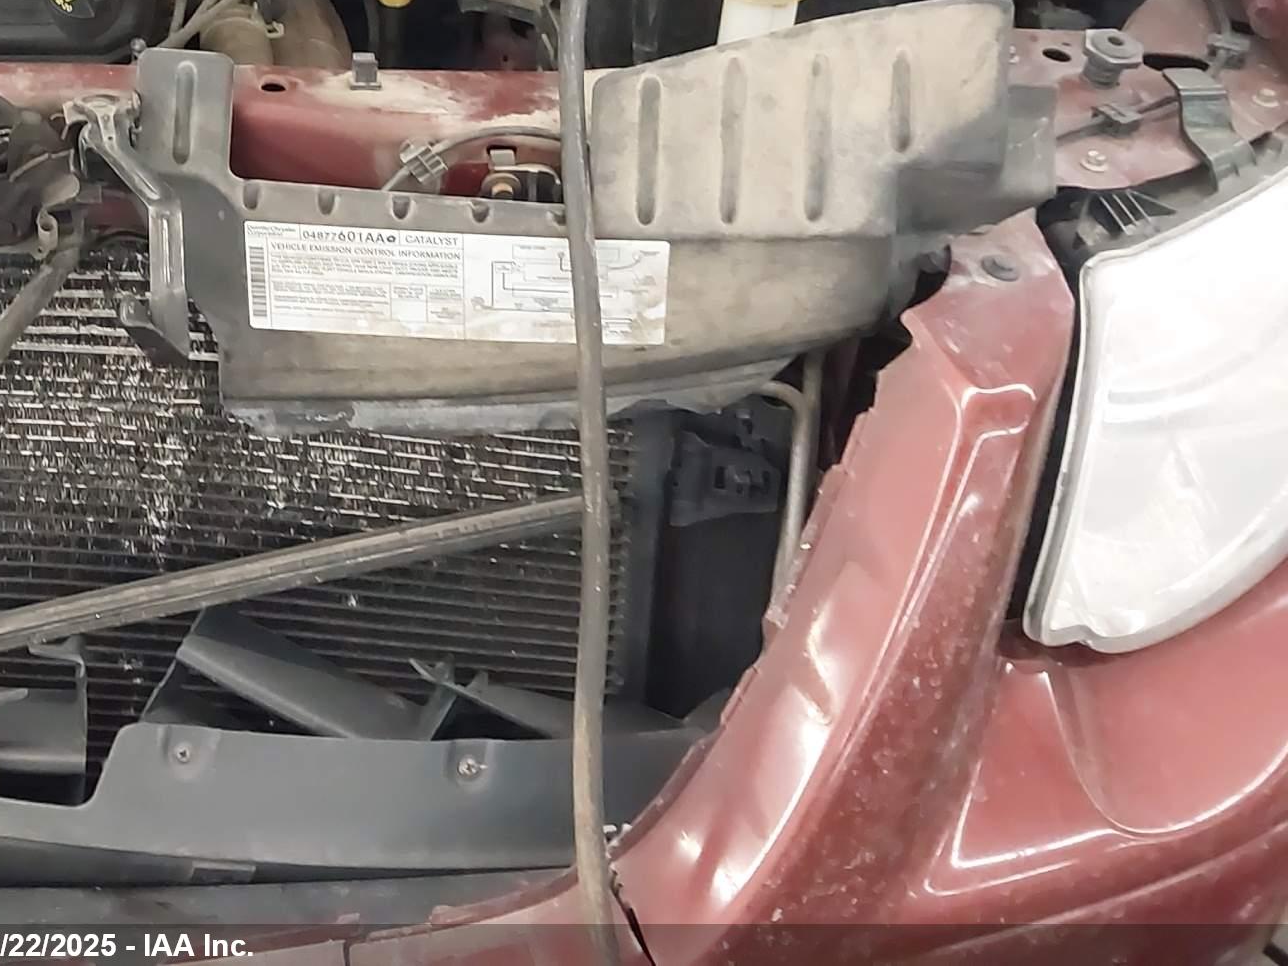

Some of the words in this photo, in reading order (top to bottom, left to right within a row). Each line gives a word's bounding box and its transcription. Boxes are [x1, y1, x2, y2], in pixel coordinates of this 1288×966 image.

[404, 234, 459, 246] CATALYST
[270, 241, 307, 252] VEHICLE
[354, 246, 396, 257] CONTROL
[398, 249, 461, 260] INFORMATION
